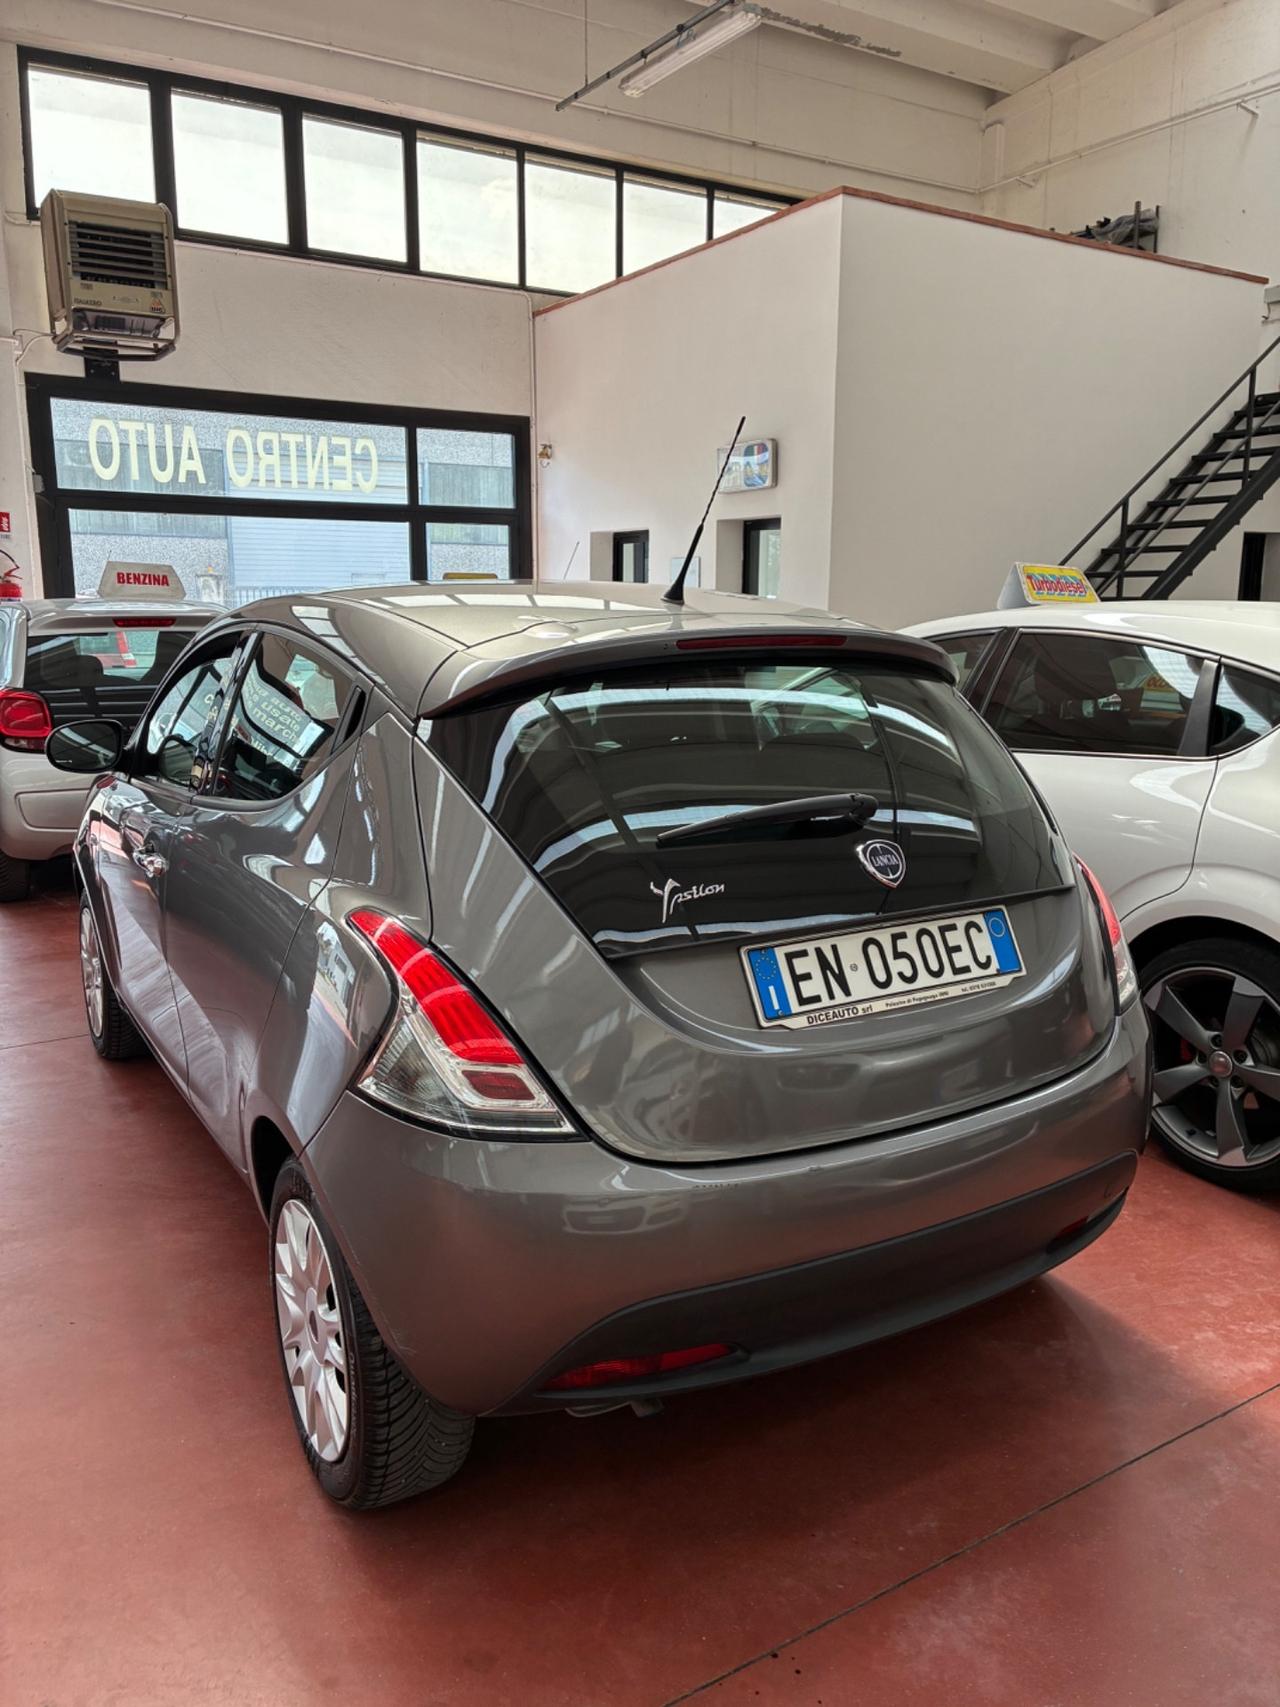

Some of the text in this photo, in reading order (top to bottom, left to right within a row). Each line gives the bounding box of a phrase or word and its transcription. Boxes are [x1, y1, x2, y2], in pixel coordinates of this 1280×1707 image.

[116, 571, 170, 587] BENZINA
[1026, 574, 1088, 595] Turbodiesel
[870, 854, 898, 867] LANCIA
[650, 878, 725, 923] Ypsilon
[784, 920, 992, 1006] EN 050EC
[806, 1005, 873, 1025] DICEAUTO srl
